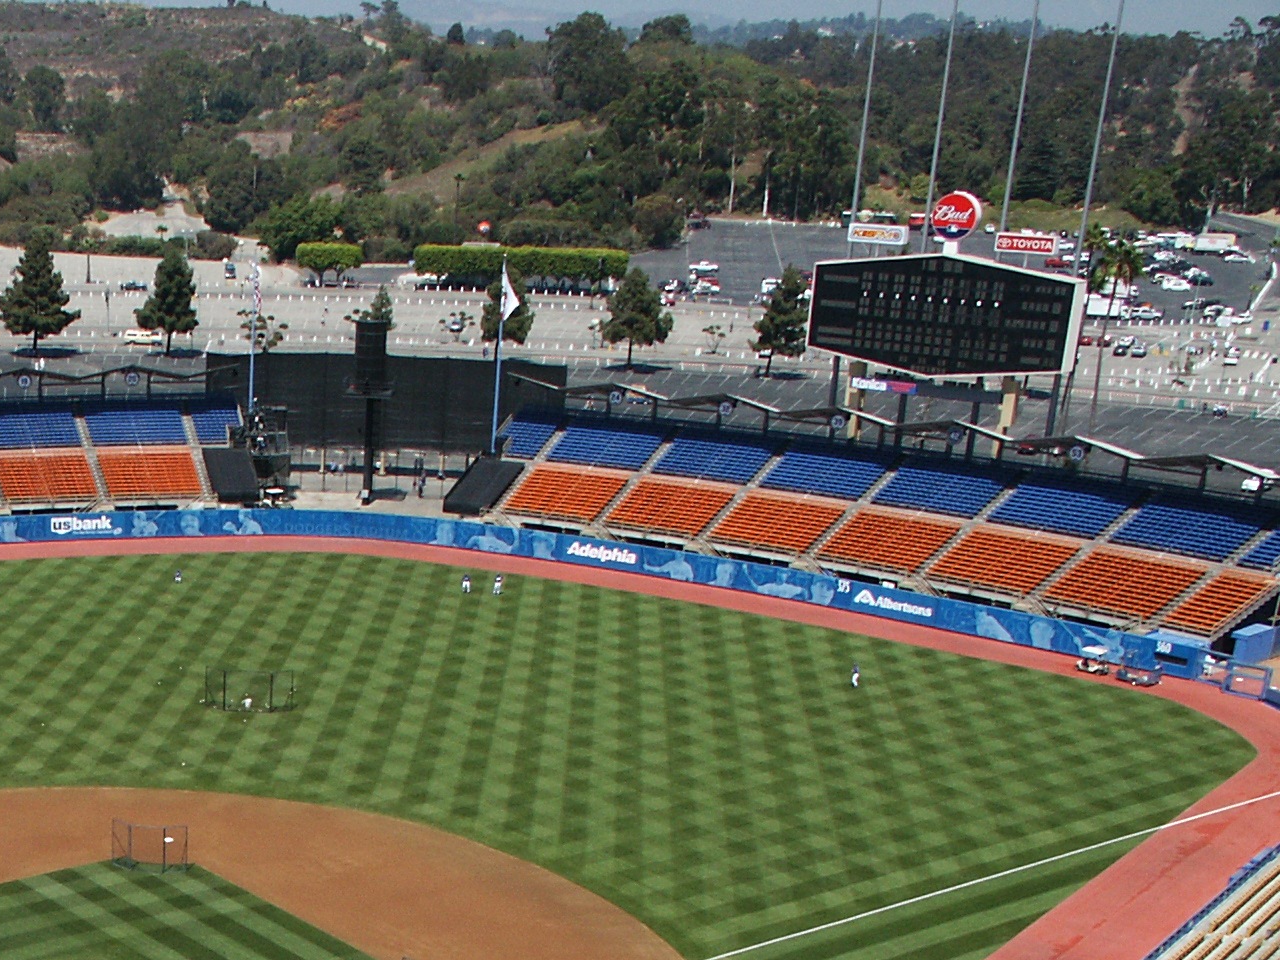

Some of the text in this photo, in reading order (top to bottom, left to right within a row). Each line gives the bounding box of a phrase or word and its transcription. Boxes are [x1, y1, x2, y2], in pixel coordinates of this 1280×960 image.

[933, 204, 973, 221] Bud
[1012, 239, 1053, 251] TOYOTA
[567, 541, 638, 564] Adelphia
[875, 596, 932, 617] Albertsons
